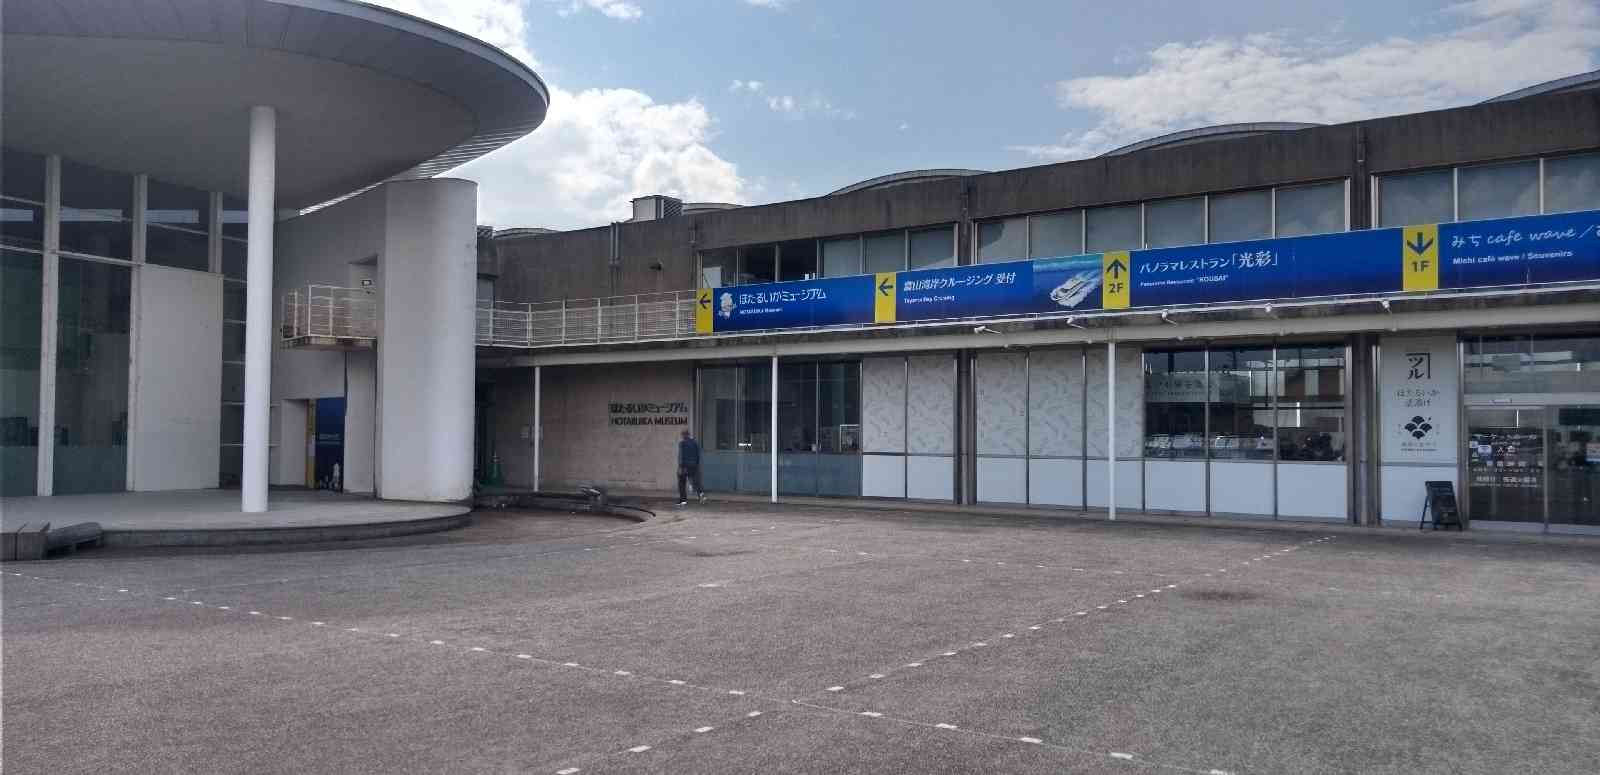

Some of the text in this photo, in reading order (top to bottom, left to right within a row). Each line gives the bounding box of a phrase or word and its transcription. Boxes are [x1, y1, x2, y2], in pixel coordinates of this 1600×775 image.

[1452, 234, 1483, 248] みち
[1487, 230, 1522, 246] cafe
[1529, 228, 1576, 242] wave
[1453, 257, 1475, 265] Michi
[1528, 251, 1573, 260] Souvenirs
[1412, 260, 1431, 273] 1F
[1108, 282, 1124, 294] 2F
[740, 288, 827, 304] ほたるいかミュージアム
[654, 416, 688, 425] MUSEUM
